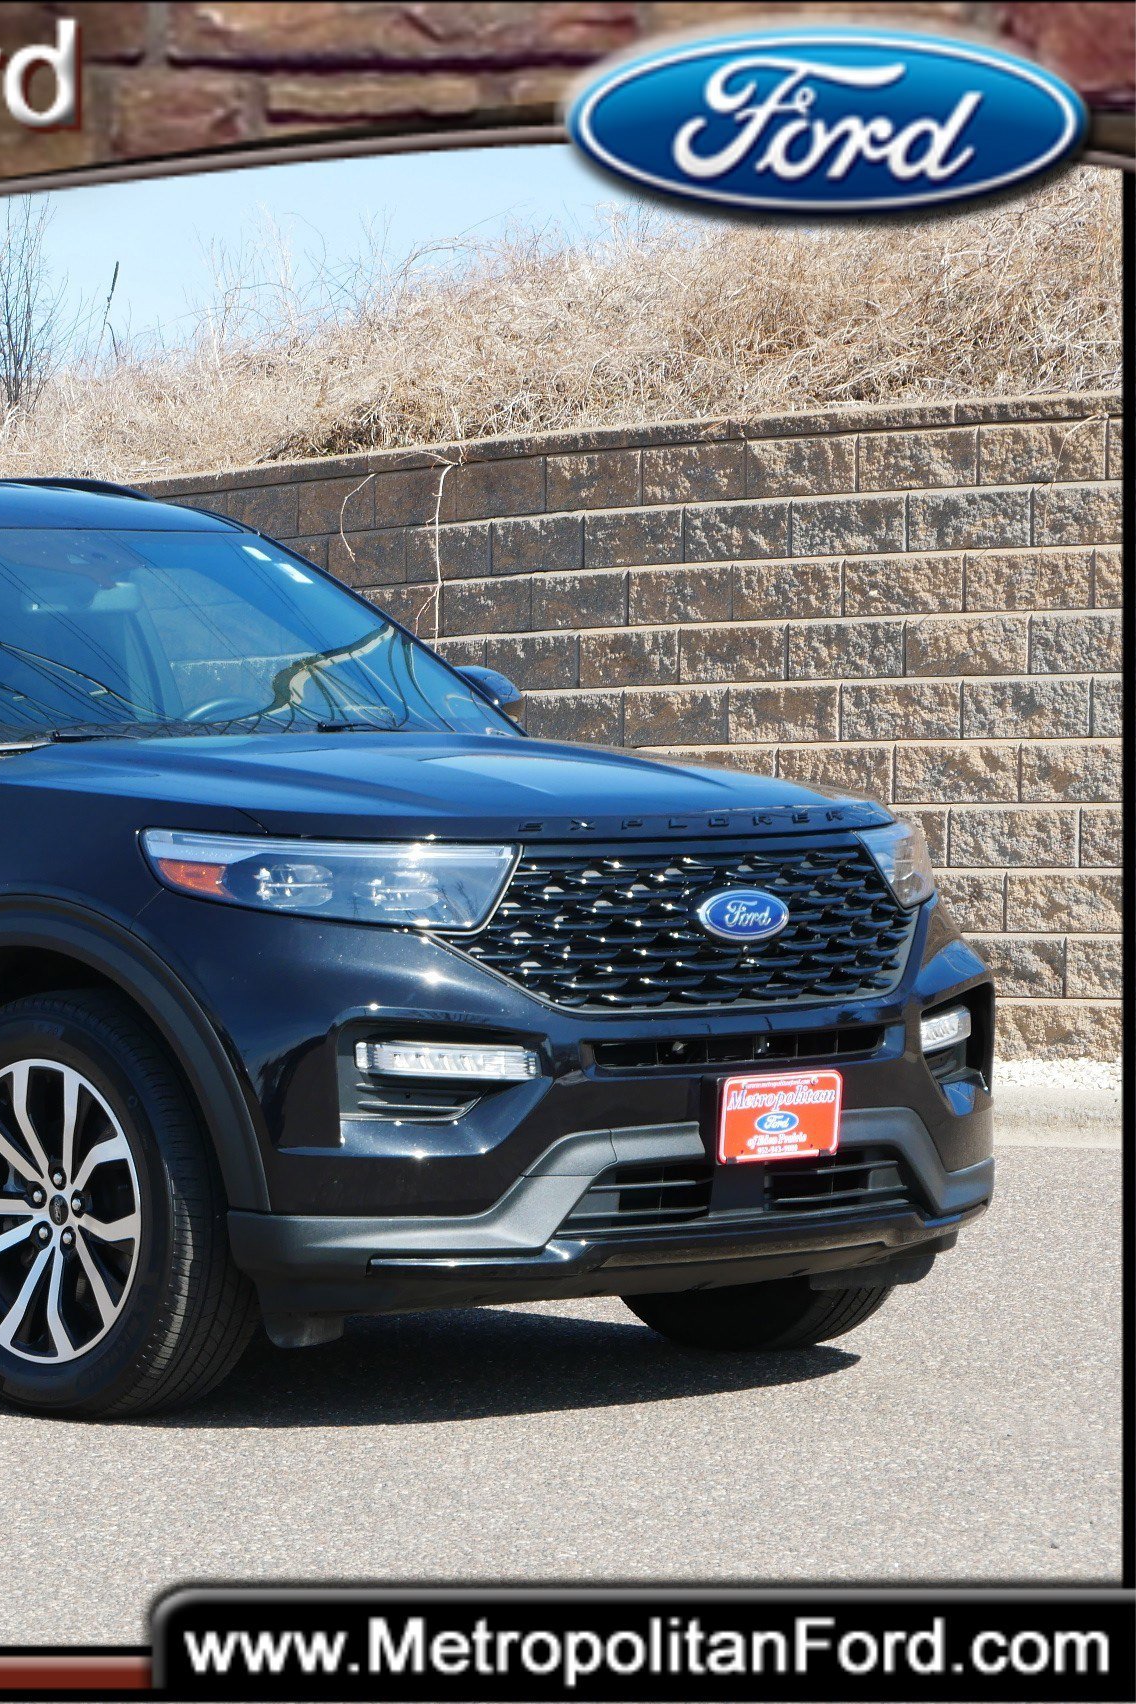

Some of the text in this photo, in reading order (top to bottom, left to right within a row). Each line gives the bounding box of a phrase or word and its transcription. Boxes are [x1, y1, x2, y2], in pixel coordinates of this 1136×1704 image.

[517, 810, 845, 833] EXPLORER
[725, 901, 771, 928] Ford
[726, 1085, 837, 1112] Metropolitan
[764, 1115, 790, 1129] Ford
